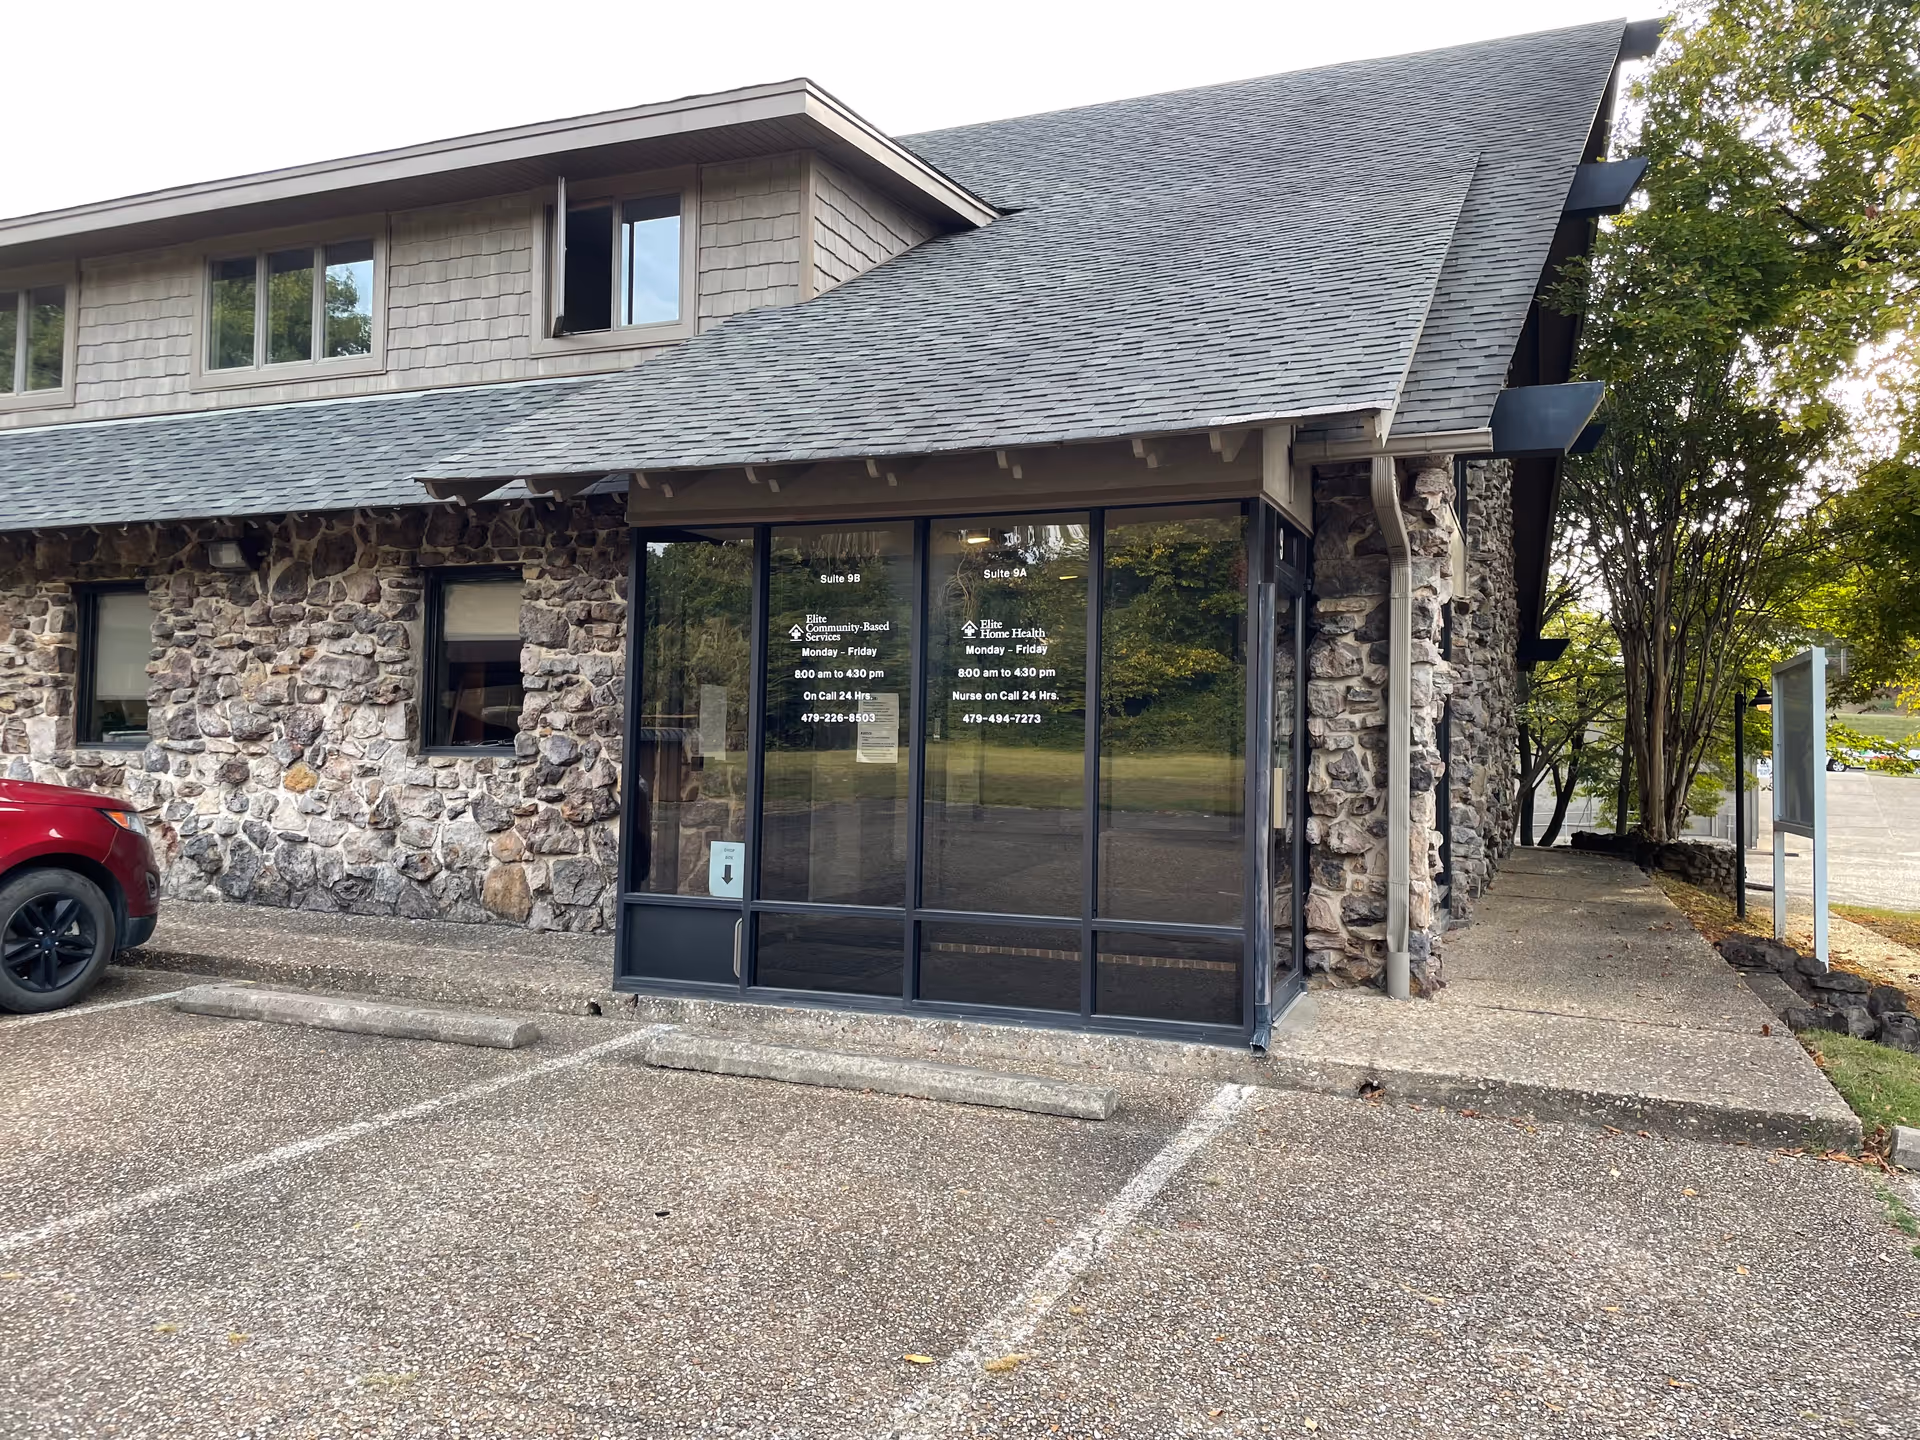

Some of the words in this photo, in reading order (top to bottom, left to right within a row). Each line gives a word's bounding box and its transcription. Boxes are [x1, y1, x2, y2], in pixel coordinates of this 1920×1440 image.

[984, 569, 1010, 579] Suite
[1013, 568, 1027, 577] 9A
[821, 574, 845, 584] Suite
[848, 574, 860, 583] 9B
[806, 615, 827, 623] Elite
[806, 621, 889, 633] Community-Based
[980, 620, 1002, 629] Elite
[806, 633, 840, 641] Services
[980, 629, 1009, 638] Home
[1012, 628, 1045, 638] Health
[802, 647, 838, 657] Monday
[848, 647, 877, 657] Friday
[966, 645, 1005, 656] Monday
[1016, 644, 1047, 655] Friday
[834, 670, 843, 678] to
[869, 670, 884, 679] pm
[983, 670, 998, 678] am
[1001, 669, 1011, 677] to
[1039, 669, 1055, 678] pm
[804, 692, 817, 700] On
[819, 691, 836, 700] Call
[839, 691, 852, 700] 24
[855, 691, 873, 700] Hrs.
[953, 691, 981, 700] Nurse
[1000, 691, 1019, 700] Call
[1022, 691, 1036, 700] 24
[1039, 690, 1059, 700] Hrs.
[801, 713, 876, 723] 479-226-8503
[963, 714, 1041, 723] 479-494-7273
